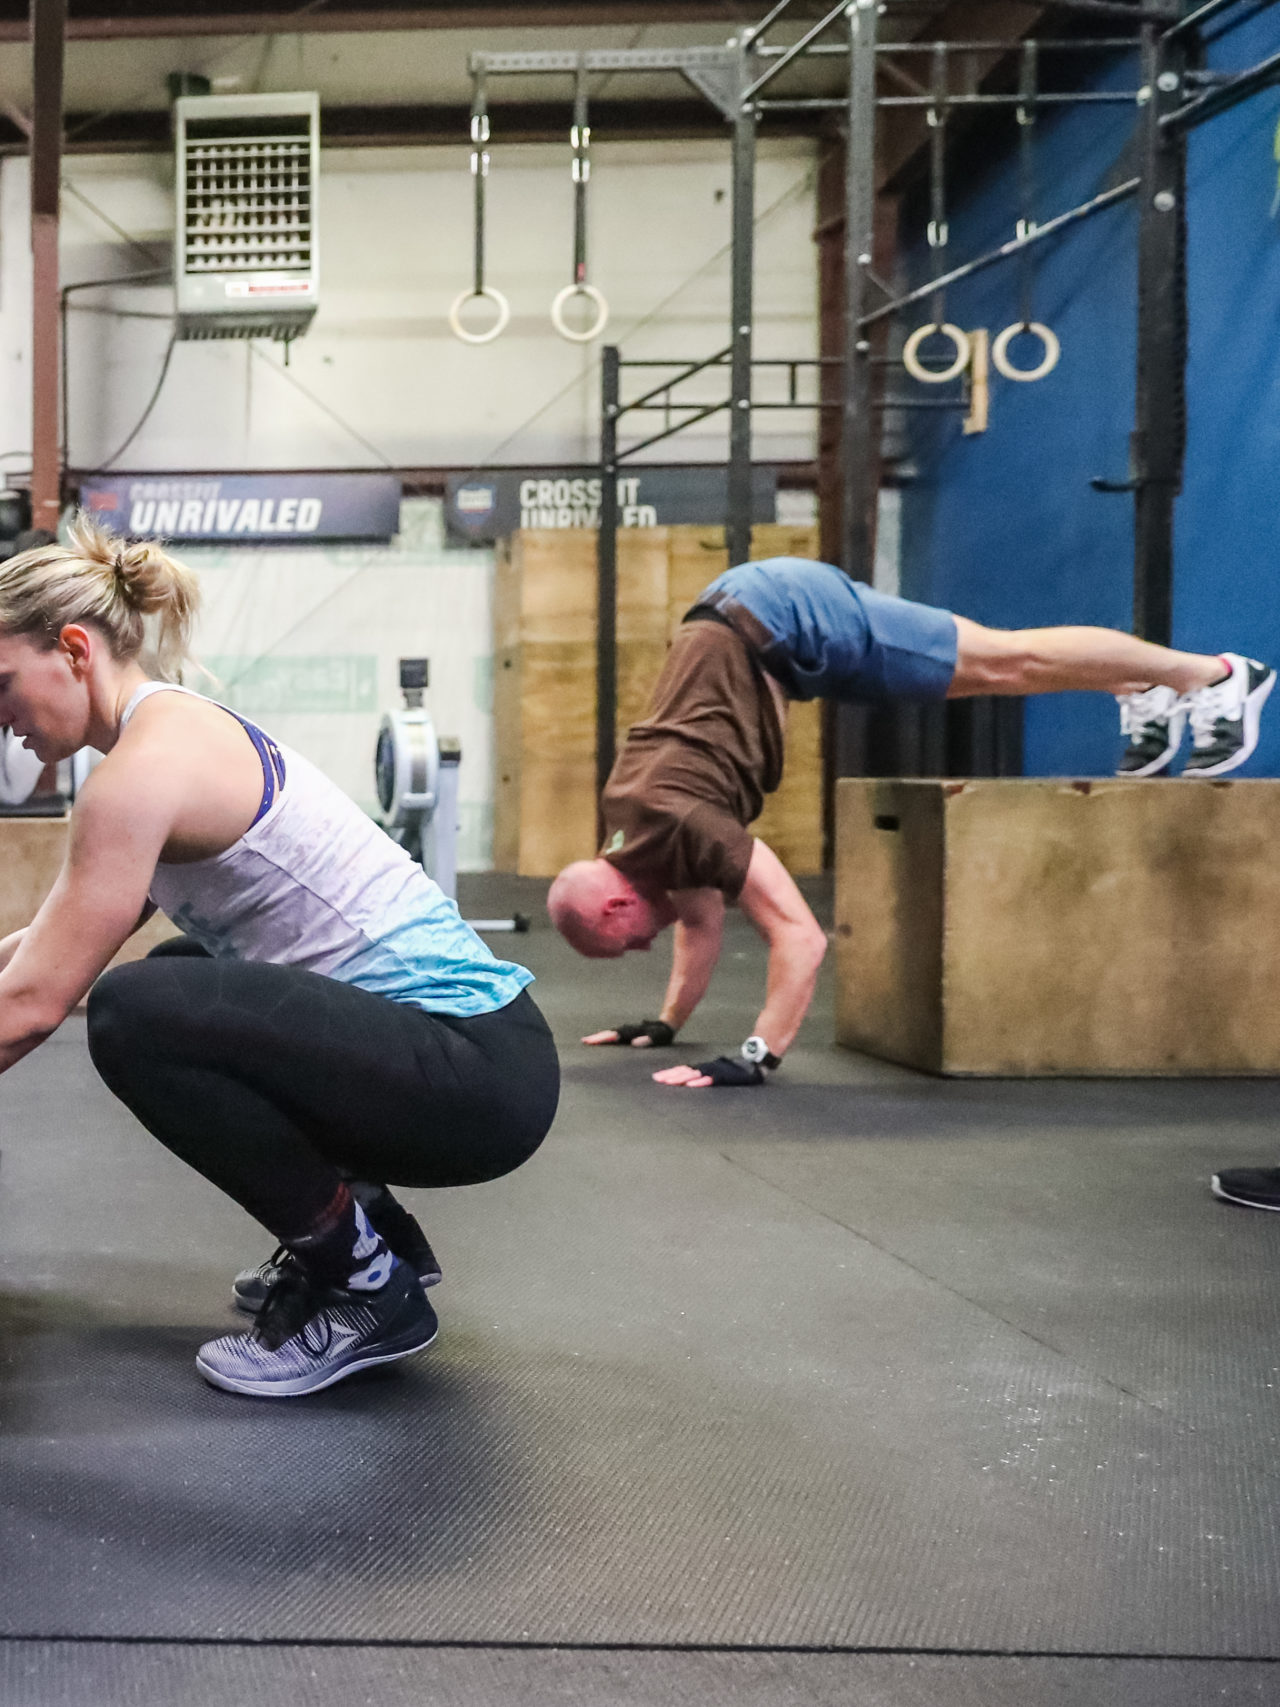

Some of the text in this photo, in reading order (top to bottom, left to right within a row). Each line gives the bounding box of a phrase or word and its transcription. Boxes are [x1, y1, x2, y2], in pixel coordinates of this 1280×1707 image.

[520, 478, 641, 507] CROSSIT
[129, 498, 322, 533] UNRIVALED
[520, 505, 657, 529] UNRIVED
